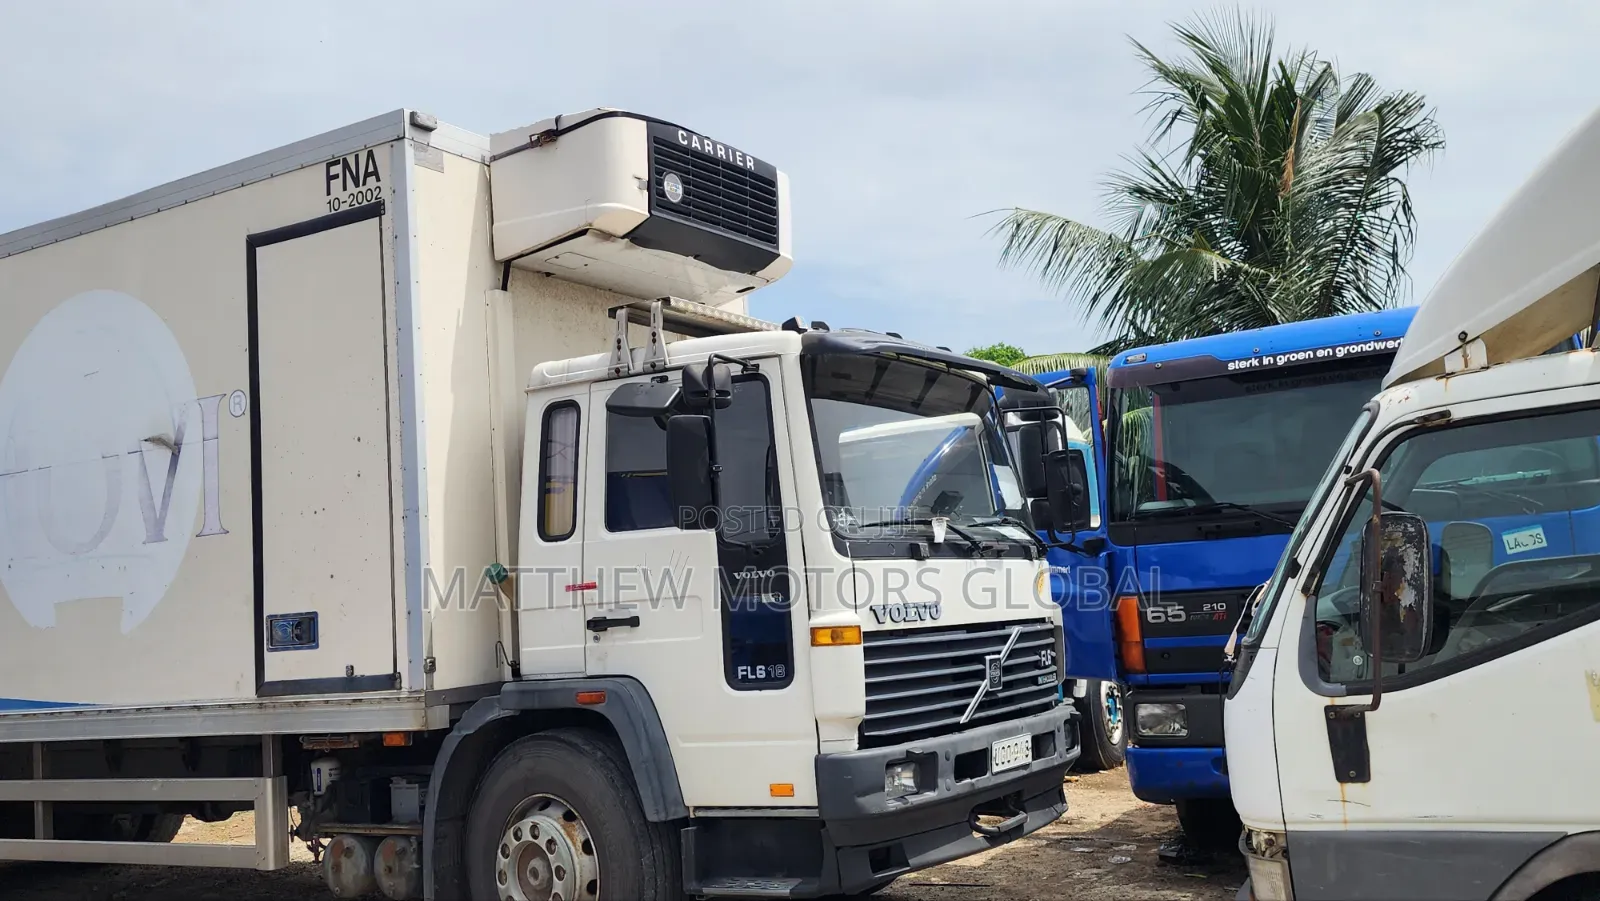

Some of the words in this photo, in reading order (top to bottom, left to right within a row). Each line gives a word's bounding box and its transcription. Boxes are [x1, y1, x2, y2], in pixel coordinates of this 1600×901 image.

[677, 129, 755, 171] CARRIER
[325, 149, 381, 196] FNA
[326, 186, 382, 213] 10-2002
[1228, 355, 1260, 371] sterk
[1263, 355, 1274, 366] in
[1276, 350, 1314, 366] groen
[1316, 349, 1333, 358] en
[733, 569, 776, 580] VOLVO
[869, 602, 942, 625] VOLVO
[1146, 605, 1187, 624] 65
[1202, 602, 1227, 611] 210
[737, 665, 766, 680] FL6
[767, 664, 786, 678] 18
